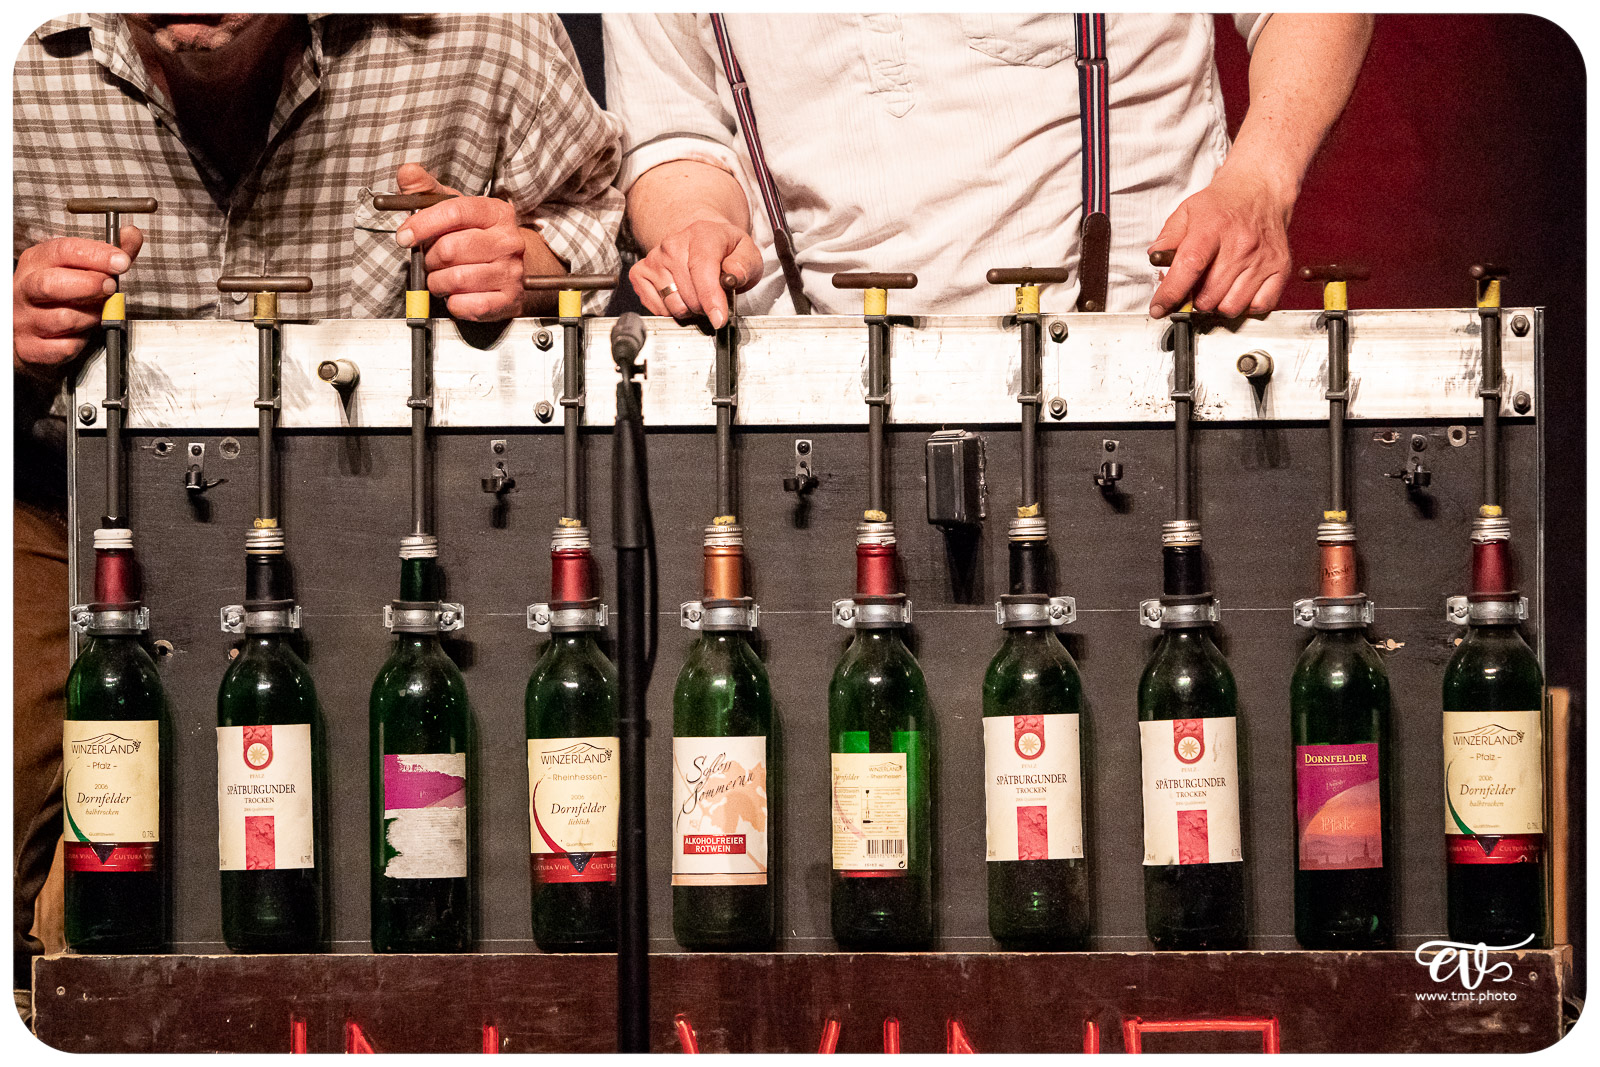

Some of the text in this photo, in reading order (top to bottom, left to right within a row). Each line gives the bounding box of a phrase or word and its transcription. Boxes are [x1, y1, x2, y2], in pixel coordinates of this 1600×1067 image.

[1452, 735, 1519, 746] WINZERLAND
[72, 744, 135, 755] WINZERLAND
[540, 753, 607, 765] WINZERLAND
[1304, 753, 1368, 764] DORNFELDER
[1476, 753, 1496, 761] Pfalz
[92, 761, 111, 770] Pfalz
[552, 772, 603, 781] Rheinhessen
[996, 773, 1068, 786] SPÄTBURGUNDER
[1155, 777, 1227, 790] SPÄTBURGUNDER
[227, 784, 297, 796] SPÄTBURGUNDER
[1016, 786, 1048, 794] TROCKEN
[1176, 790, 1207, 798] TROCKEN
[1460, 784, 1517, 800] Dornfelder
[77, 792, 132, 808] Dornfelder
[244, 796, 275, 804] TROCKEN
[85, 808, 120, 816] halbtrocken
[550, 801, 607, 818] Dornfelder
[567, 818, 591, 826] lieblich
[684, 836, 744, 845] ALKOHOLFREIER
[695, 845, 731, 853] ROTWEIN
